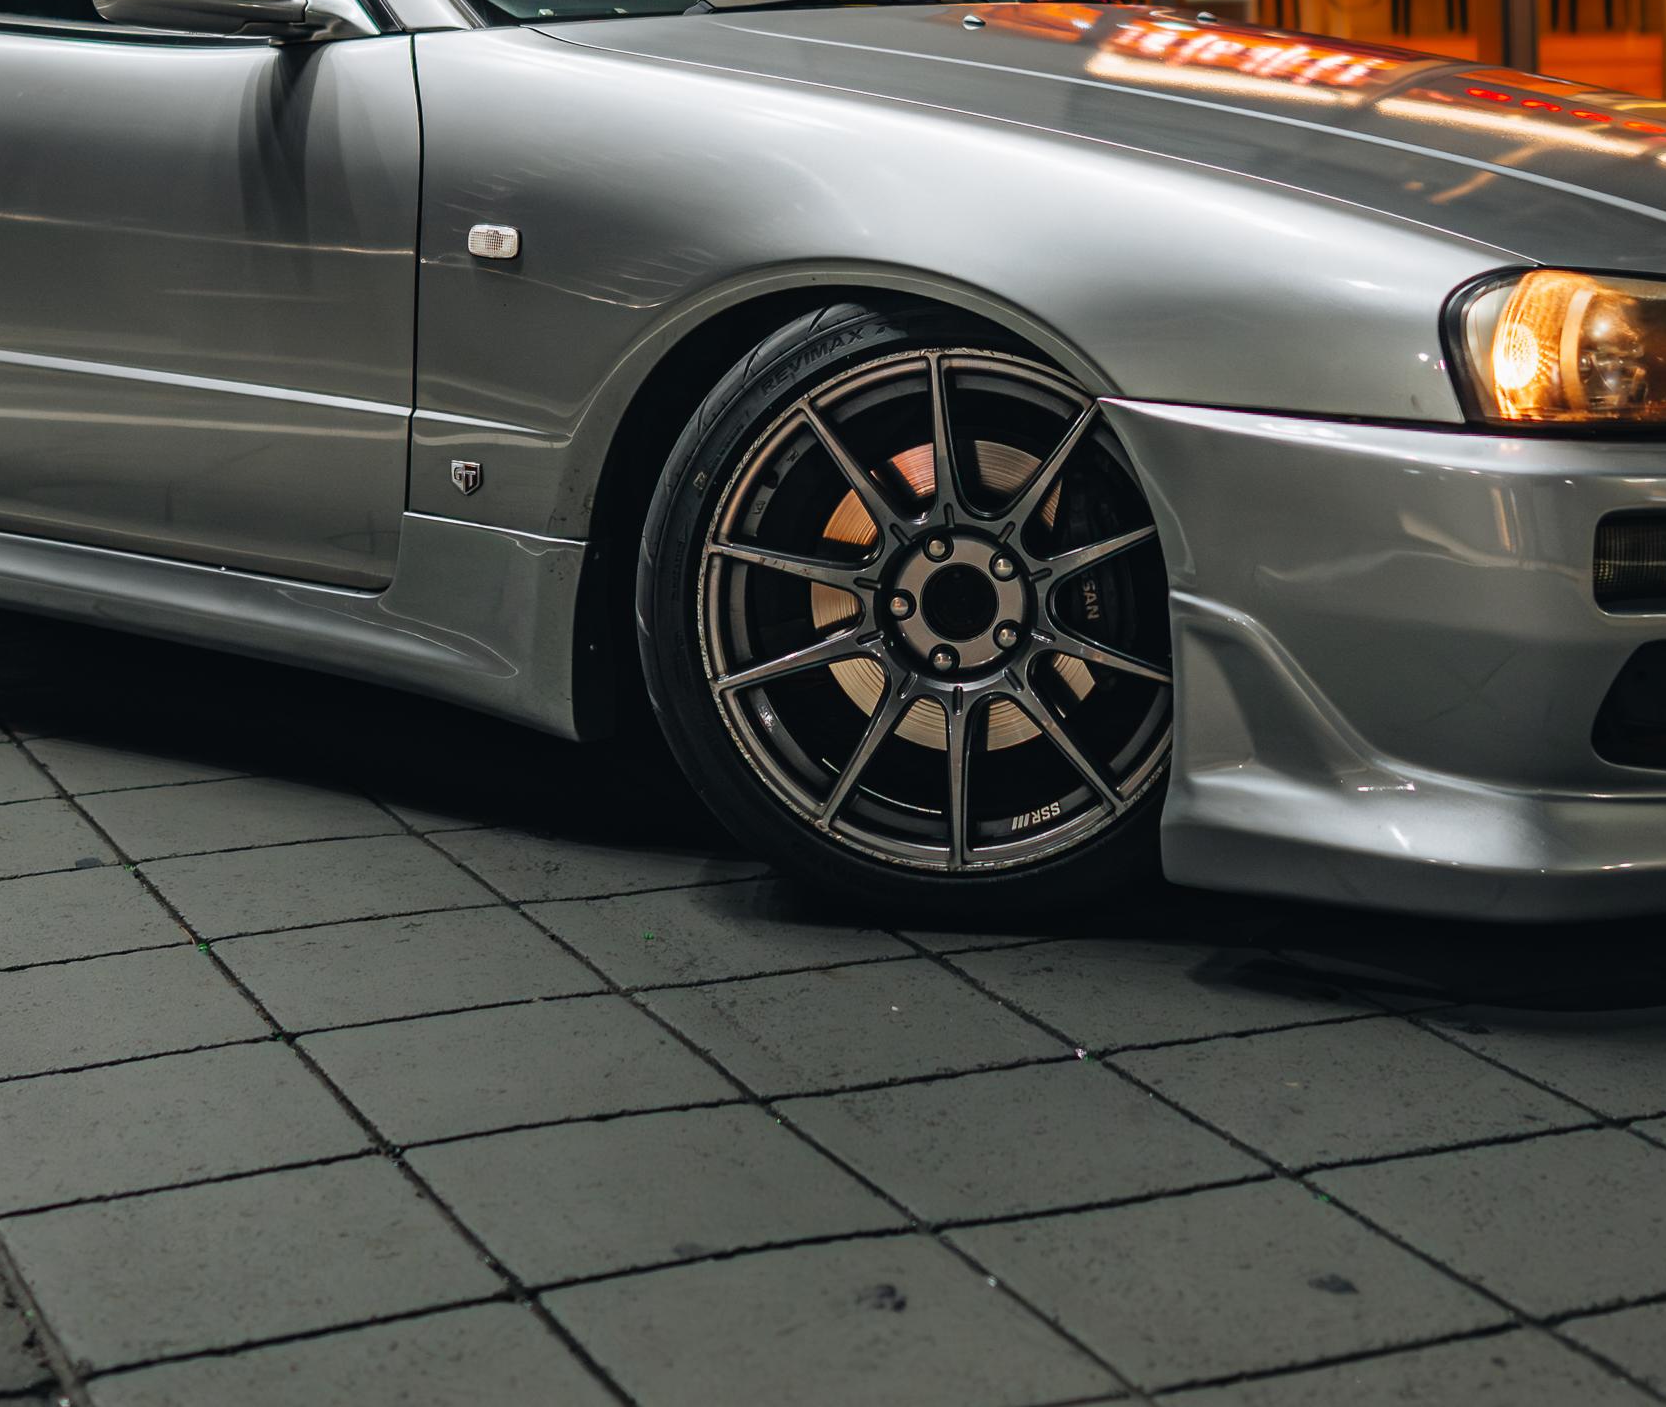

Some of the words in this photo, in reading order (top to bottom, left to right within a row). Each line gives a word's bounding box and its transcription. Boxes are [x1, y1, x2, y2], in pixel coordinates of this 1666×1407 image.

[760, 328, 864, 397] REVIMAX
[453, 466, 477, 488] GT
[1082, 575, 1101, 621] SAN
[1030, 800, 1062, 825] SSR
